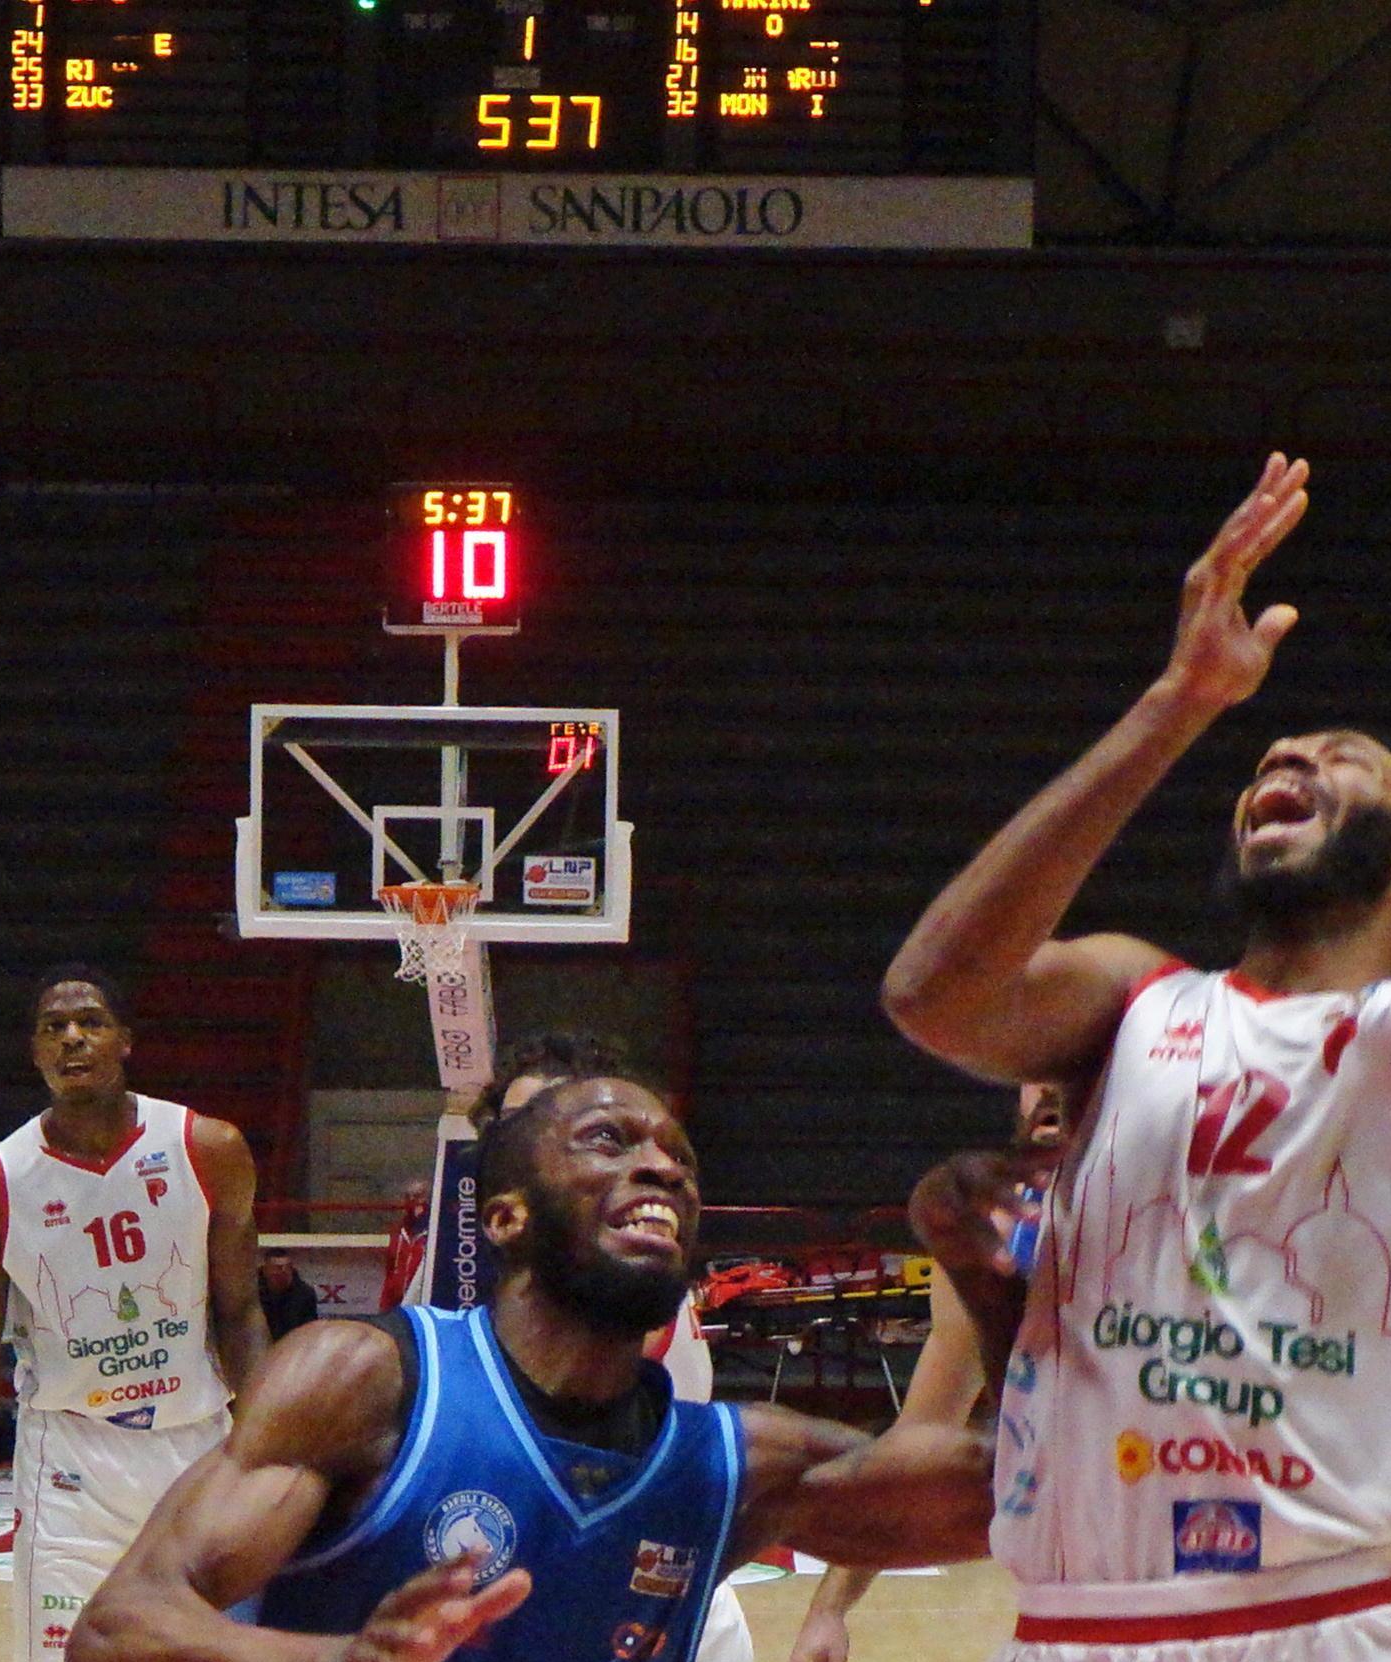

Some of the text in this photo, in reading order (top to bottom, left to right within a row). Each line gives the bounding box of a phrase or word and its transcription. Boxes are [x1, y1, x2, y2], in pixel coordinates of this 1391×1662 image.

[11, 57, 43, 81] 25
[12, 83, 44, 109] 33
[221, 179, 407, 230] INTESA
[527, 184, 806, 236] SANPAOLO
[424, 491, 511, 525] 5:37
[432, 530, 506, 599] 10
[83, 1209, 147, 1268] 16
[66, 1327, 149, 1359] Giorgio
[1093, 1302, 1357, 1377] Giorgio Tesi
[98, 1348, 169, 1377] Group
[110, 1376, 182, 1402] CONAD
[1138, 1360, 1284, 1429] Group
[1157, 1436, 1315, 1490] CONAD
